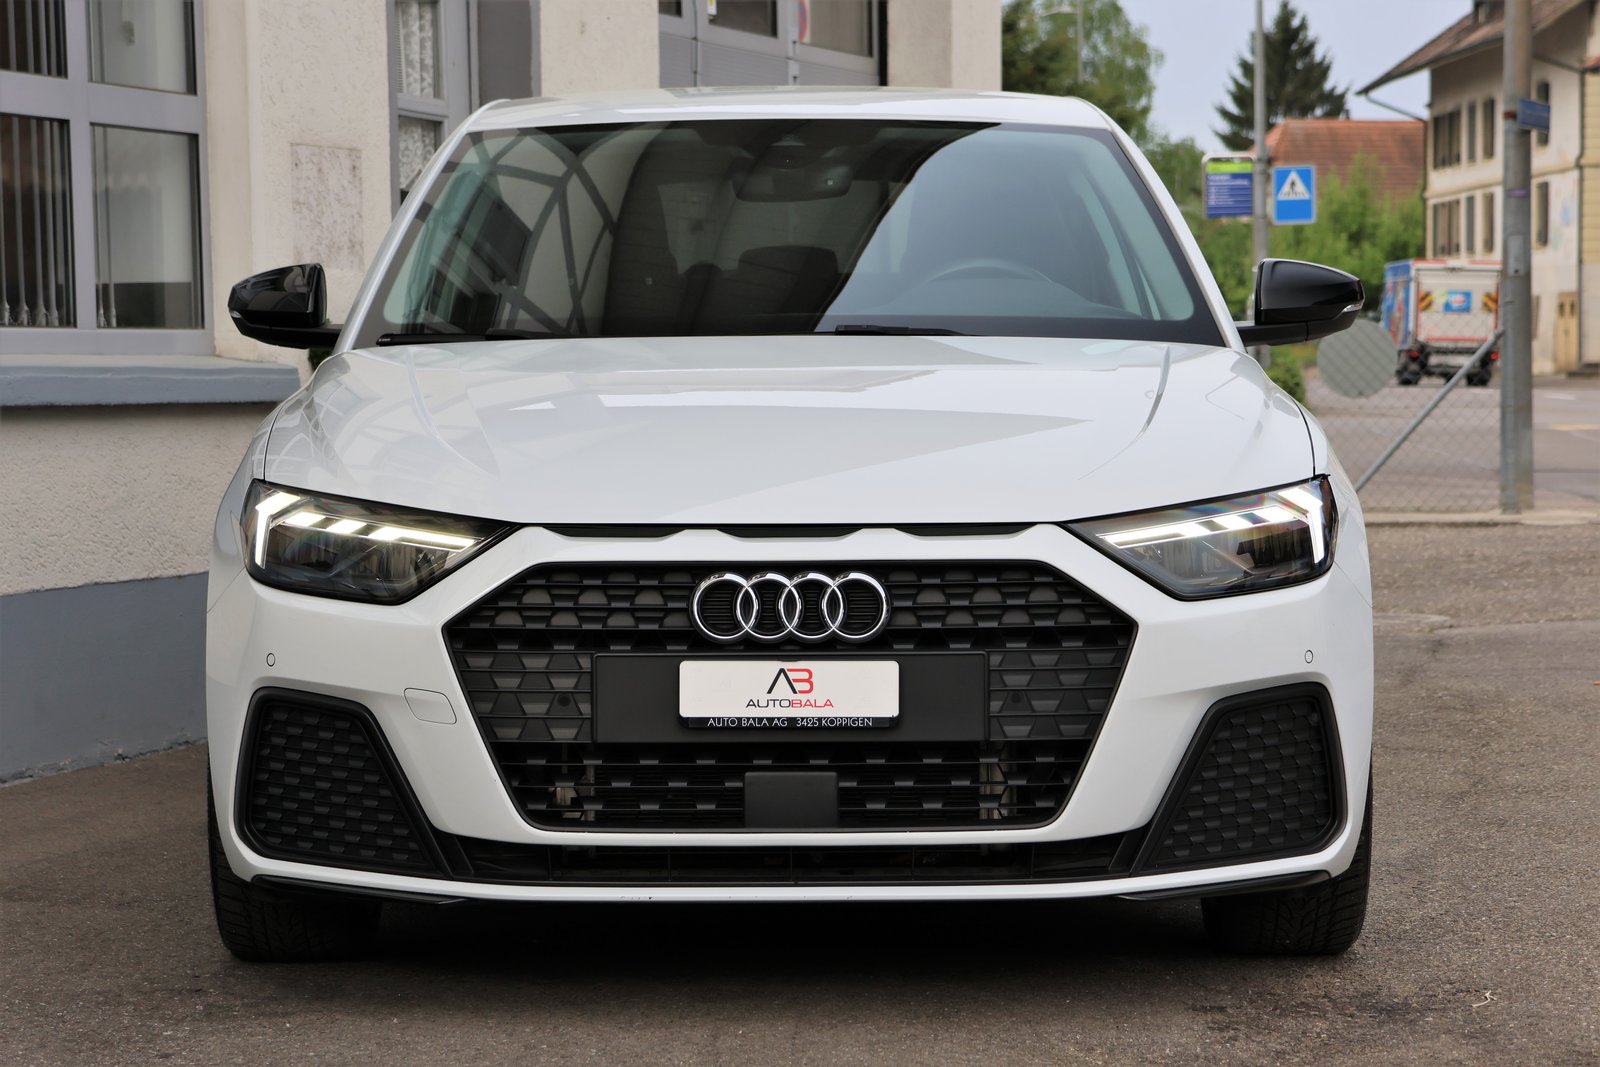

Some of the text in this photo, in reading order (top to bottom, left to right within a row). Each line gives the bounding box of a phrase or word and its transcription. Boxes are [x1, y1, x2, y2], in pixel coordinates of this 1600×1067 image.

[746, 699, 834, 708] AUTOBALA
[707, 718, 872, 727] AUTO BALA AG 3425 KOPPIGEN
